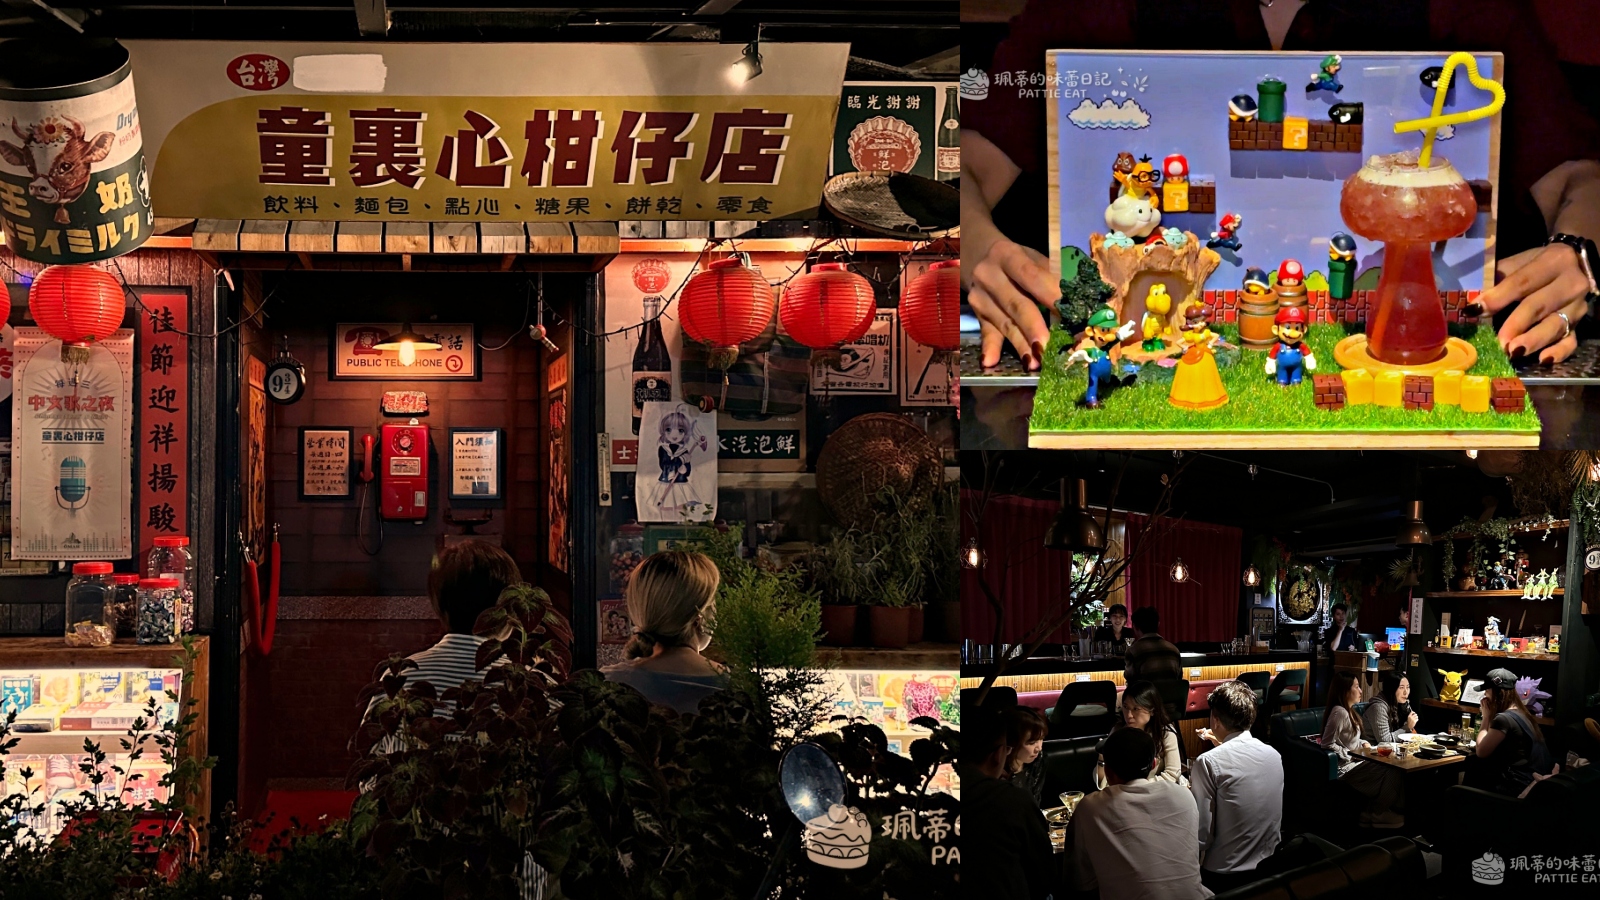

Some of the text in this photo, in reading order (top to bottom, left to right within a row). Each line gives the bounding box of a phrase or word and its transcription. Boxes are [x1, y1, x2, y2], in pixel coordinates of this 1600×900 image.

[236, 59, 279, 88] 台灣
[256, 106, 793, 190] 童裏心柑仔店
[346, 358, 443, 367] PUBLIC TELHONE
[28, 394, 115, 412] 中文歌之夜
[42, 431, 105, 441] 童裏心柑仔店
